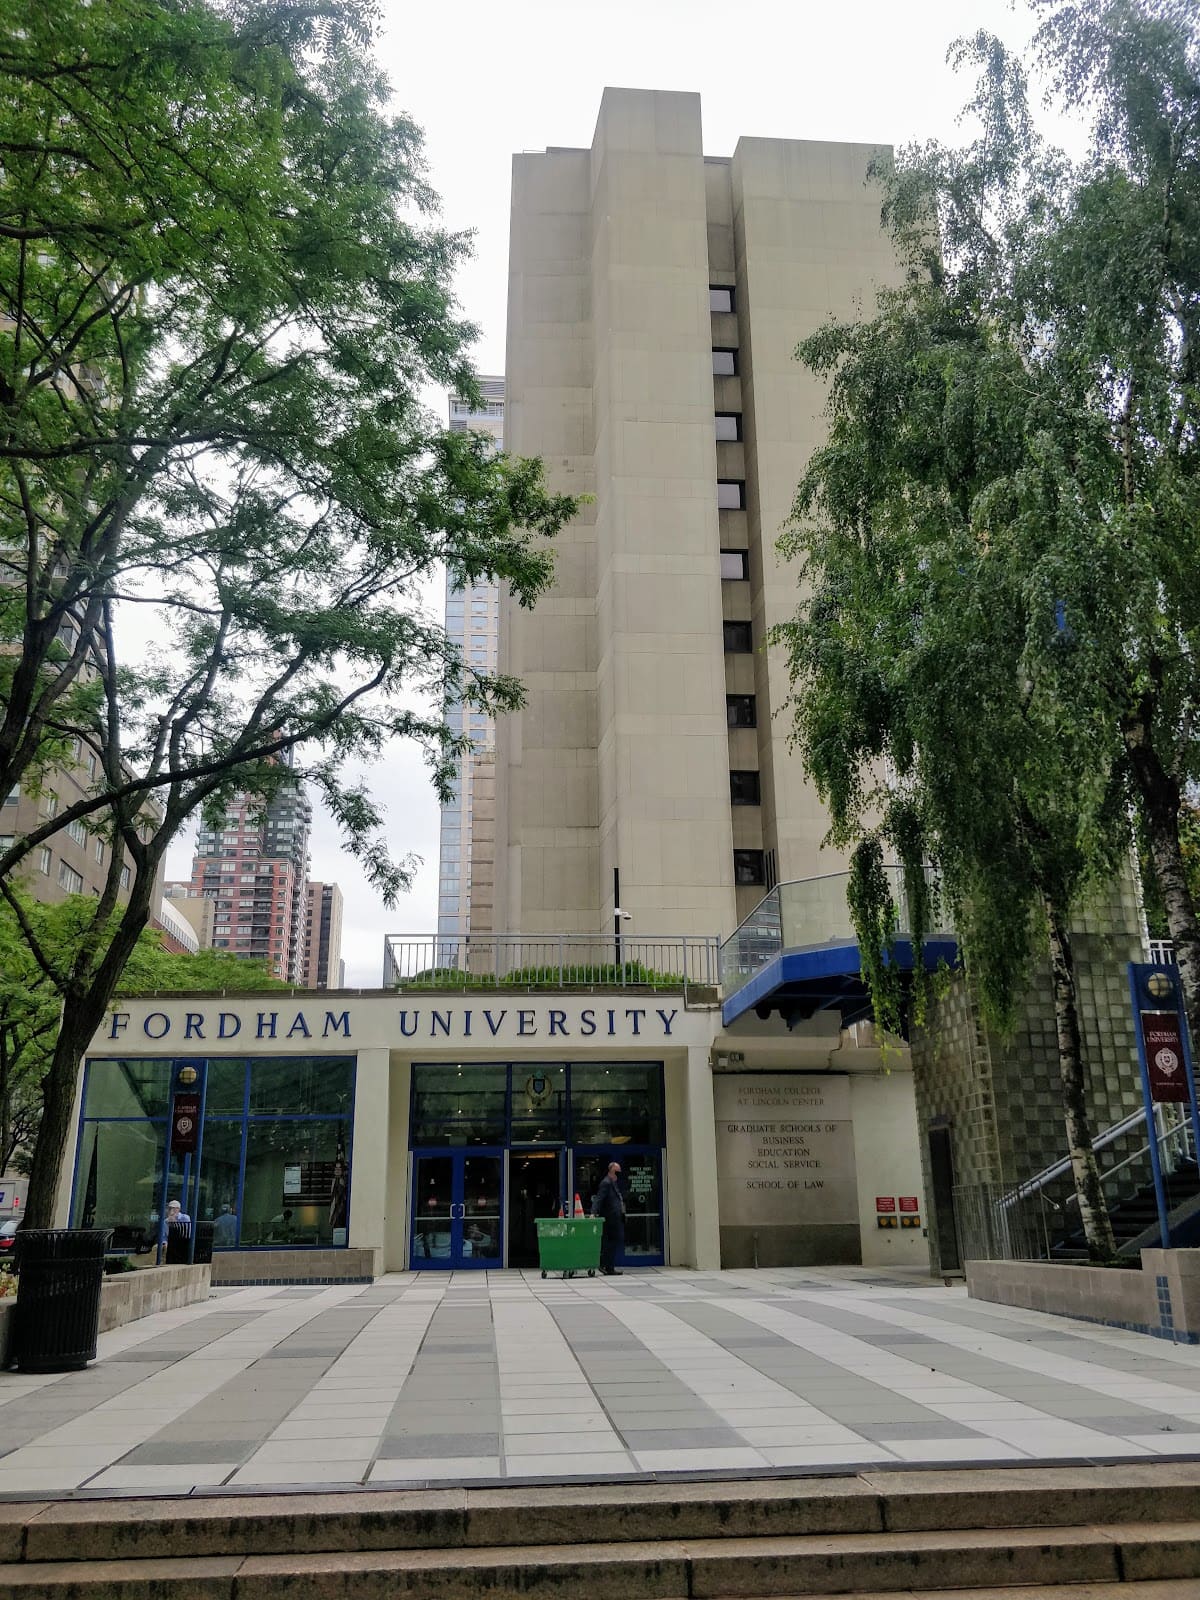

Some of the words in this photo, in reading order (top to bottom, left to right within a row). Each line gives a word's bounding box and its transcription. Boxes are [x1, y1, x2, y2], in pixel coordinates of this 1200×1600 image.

[108, 1011, 351, 1039] FORDHAM
[399, 1009, 678, 1036] UNIVERSITY
[727, 1124, 776, 1133] GRADUATE
[780, 1124, 821, 1133] SCHOOLS
[824, 1124, 838, 1133] OF
[762, 1136, 804, 1145] BUSINESS
[757, 1148, 810, 1157] EDUCATION
[748, 1160, 779, 1169] SOCIAL
[783, 1160, 822, 1169] SERVICE
[746, 1181, 784, 1190] SCHOOL
[787, 1181, 801, 1190] OF
[804, 1181, 824, 1190] LAW
